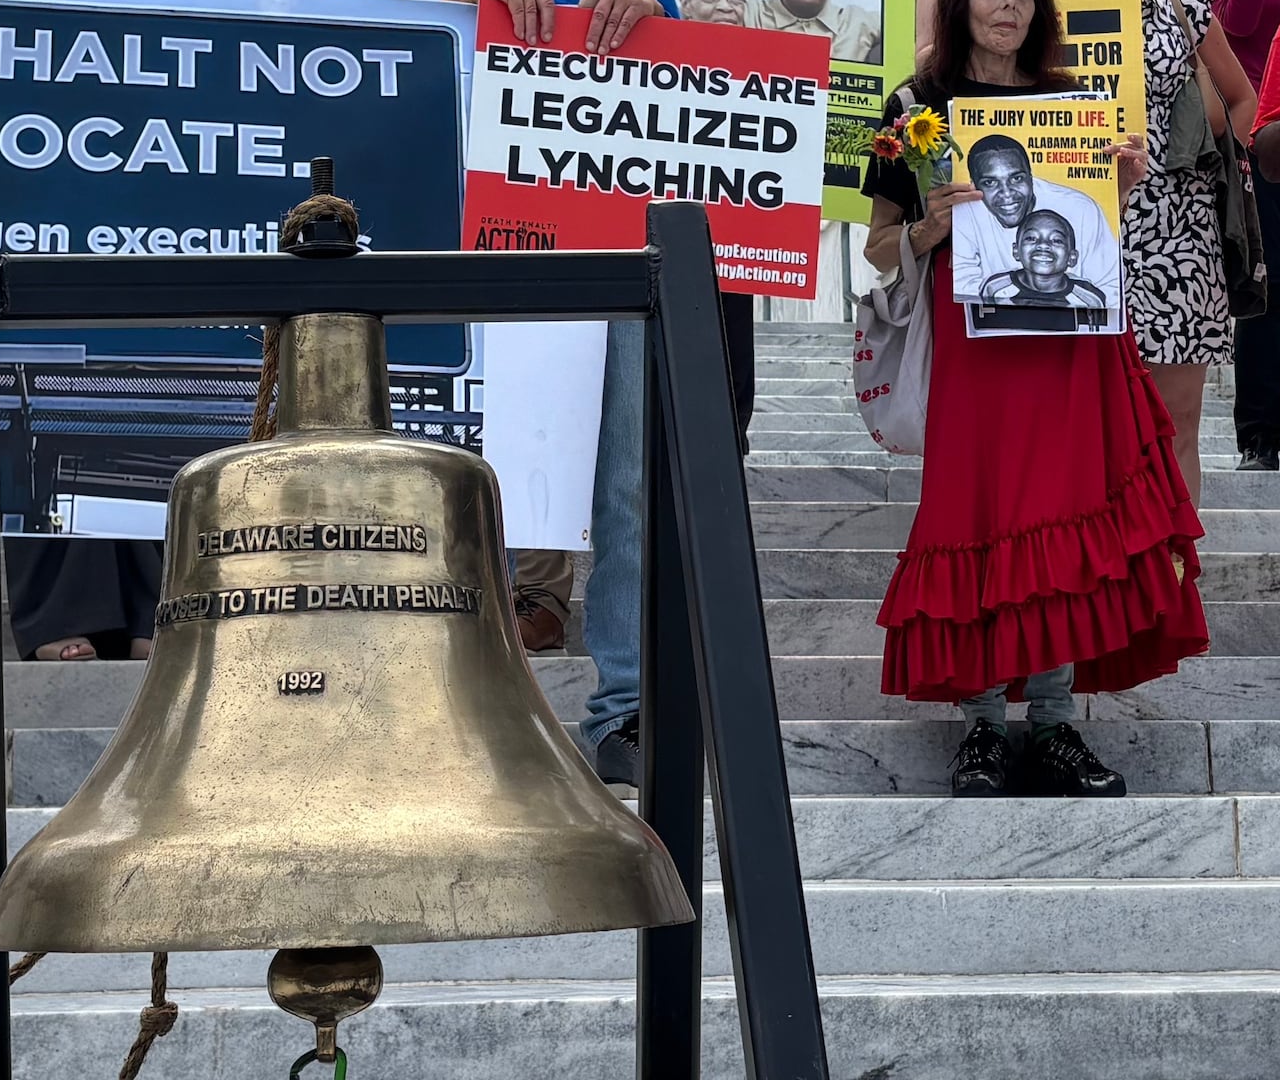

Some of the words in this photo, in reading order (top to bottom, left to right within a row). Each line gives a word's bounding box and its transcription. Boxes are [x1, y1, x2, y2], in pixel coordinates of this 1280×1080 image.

[1082, 41, 1122, 66] FOR
[239, 41, 413, 97] NOT
[487, 47, 730, 97] EXECUTIONS
[740, 75, 816, 106] ARE
[846, 77, 876, 90] LIFE
[829, 93, 873, 106] THEM.
[500, 89, 797, 153] LEGALIZED
[960, 109, 985, 126] THE
[989, 110, 1025, 127] JURY
[1030, 110, 1073, 127] VOTED
[1077, 110, 1110, 128] LIFE.
[1028, 137, 1077, 149] ALABAMA
[1081, 138, 1112, 149] PLANS
[1031, 152, 1043, 164] TO
[1046, 152, 1089, 164] EXECUTE
[1092, 152, 1113, 165] HIM
[507, 145, 784, 208] LYNCHING
[1067, 166, 1113, 180] ANYWAY.
[481, 217, 511, 226] DEATH
[516, 220, 558, 230] PENALTY
[475, 226, 556, 251] ACTION
[198, 524, 314, 557] DELAWARE
[322, 524, 427, 551] CITIZENS
[219, 591, 245, 614] TO
[251, 587, 297, 611] THE
[307, 585, 389, 610] DEATH
[396, 585, 483, 612] PENALTY
[278, 672, 323, 691] 1992
